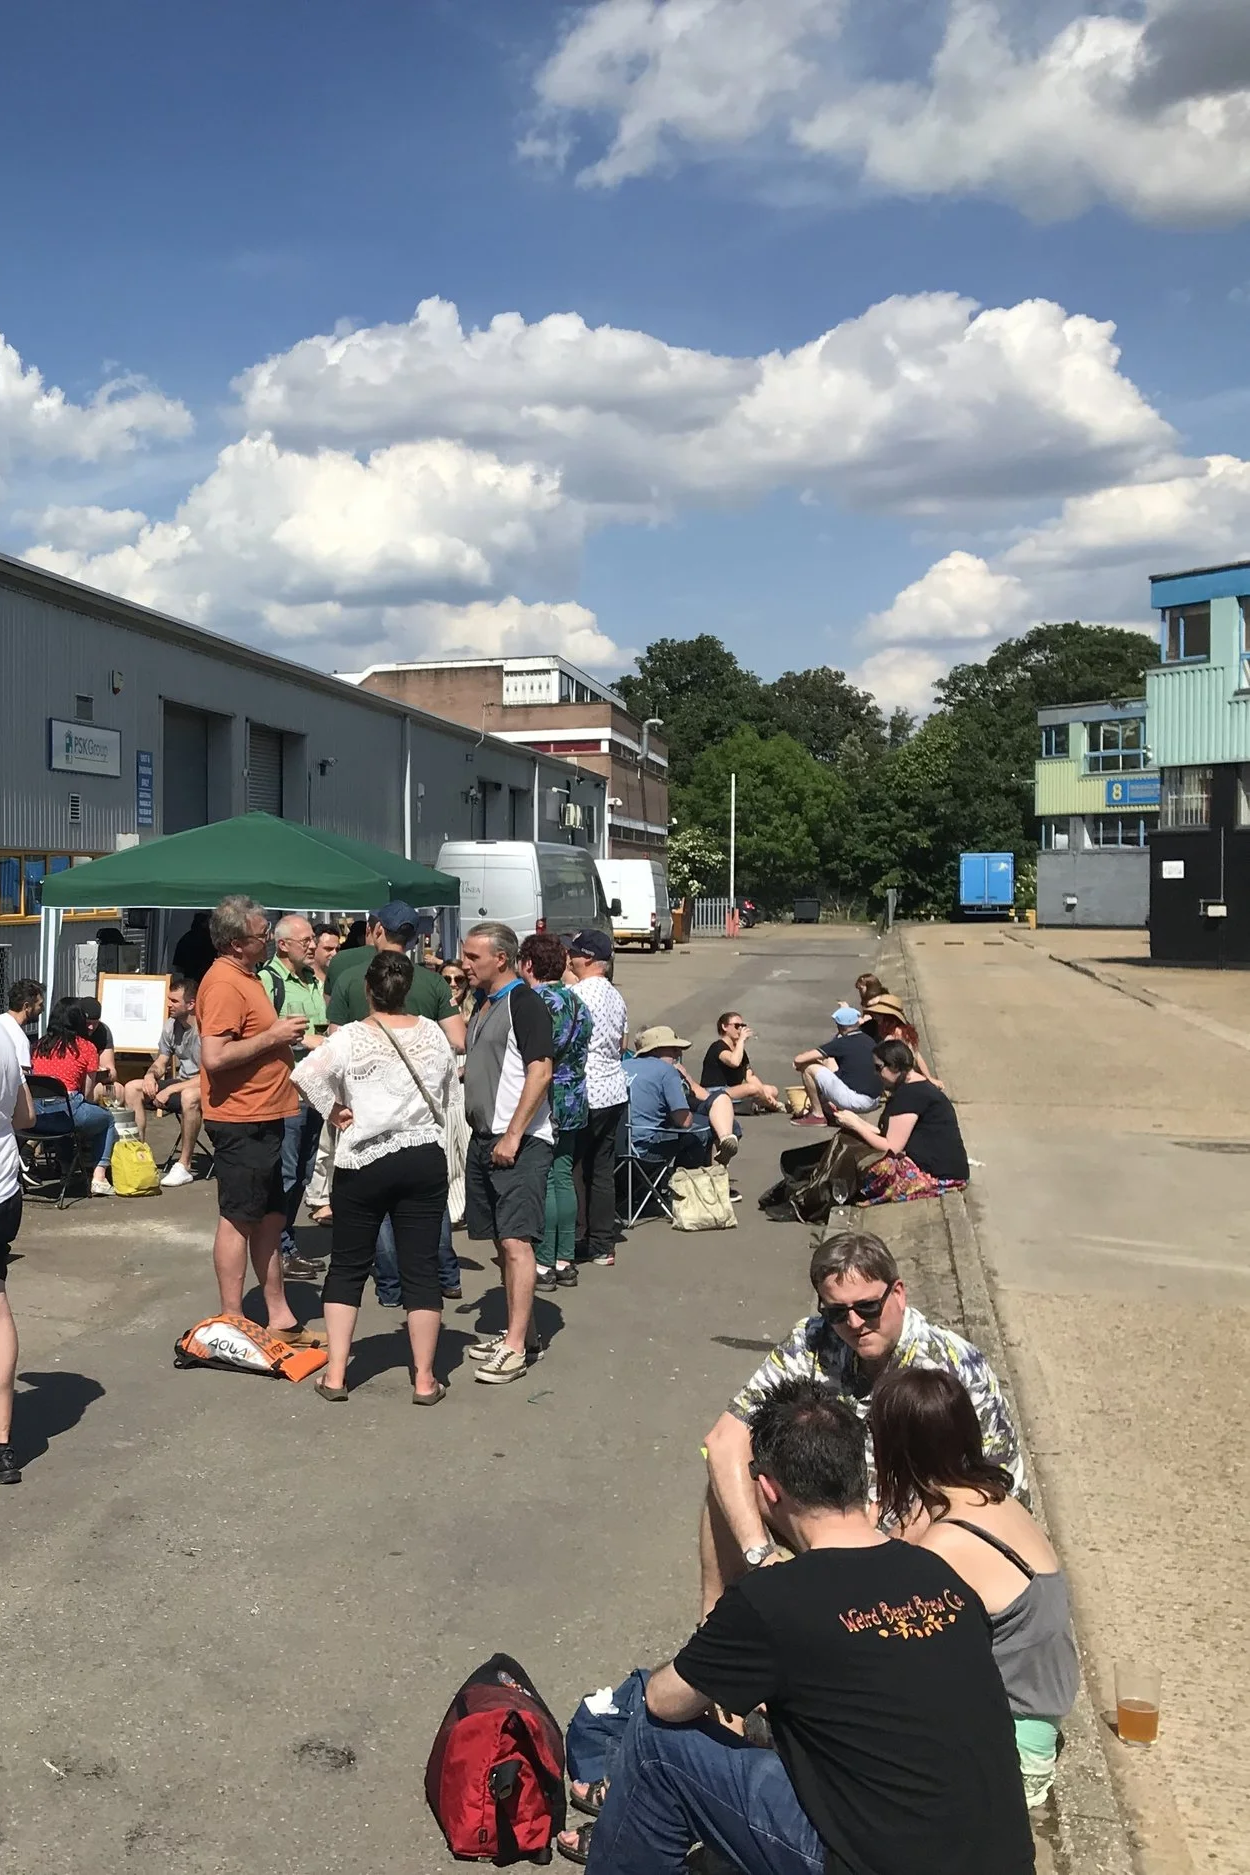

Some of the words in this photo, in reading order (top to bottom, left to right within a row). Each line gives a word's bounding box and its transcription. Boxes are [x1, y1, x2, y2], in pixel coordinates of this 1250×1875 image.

[1112, 783, 1122, 801] 8
[839, 1608, 882, 1632] Weird
[879, 1601, 917, 1625] Beard
[912, 1595, 945, 1617] Brew
